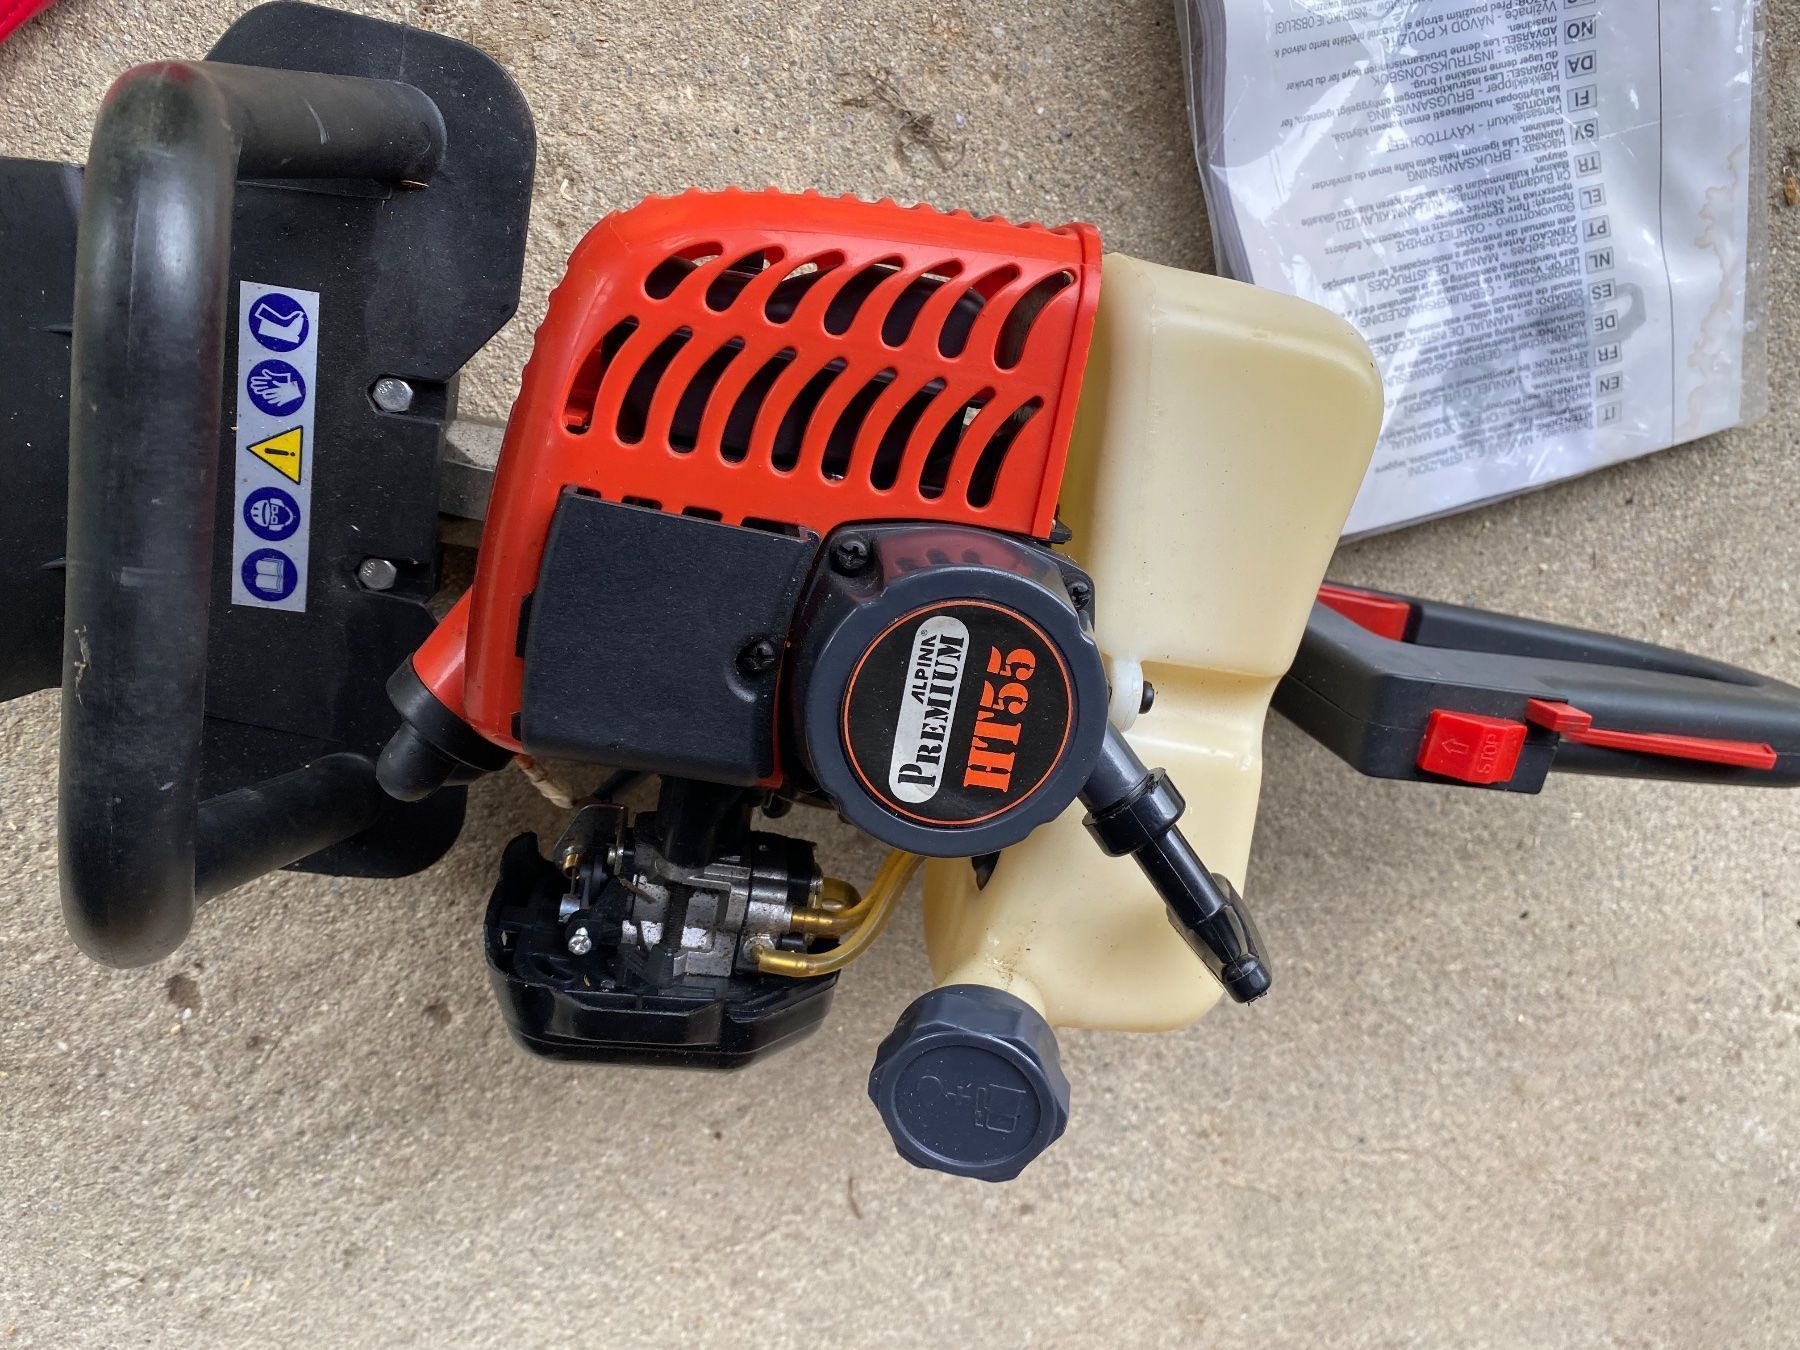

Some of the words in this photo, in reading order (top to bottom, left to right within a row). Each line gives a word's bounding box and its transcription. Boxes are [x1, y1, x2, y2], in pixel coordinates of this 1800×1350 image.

[1414, 11, 1443, 29] stroje
[1451, 13, 1494, 36] NÁVOD
[1507, 14, 1557, 34] maskinen.
[1567, 18, 1592, 40] NO
[1439, 23, 1447, 37] K
[1502, 24, 1558, 45] ADVARSEL:
[1449, 41, 1480, 57] denne
[1482, 36, 1499, 49] Les
[1505, 34, 1557, 57] Hekksaks
[1519, 51, 1542, 66] tager
[1546, 49, 1558, 60] du
[1569, 53, 1593, 74] DA
[1445, 65, 1487, 83] maskine
[1489, 58, 1517, 73] denne
[1506, 58, 1558, 79] ADVARSEL:
[1285, 77, 1313, 92] bruker
[1394, 74, 1480, 104] instruktionsbogen
[1410, 75, 1436, 91] brug.
[1485, 65, 1558, 96] Hækkeklipper
[1367, 87, 1473, 123] BRUGSANVISNING
[1512, 92, 1560, 112] VAROITUS:
[1574, 88, 1589, 107] FI
[1403, 112, 1429, 124] ennen
[1432, 98, 1493, 119] huolellisesti
[1487, 102, 1561, 130] Pensasleikkuri
[1520, 116, 1563, 135] maskinen.
[1521, 126, 1564, 144] VARNING:
[1574, 122, 1593, 141] SV
[1461, 139, 1498, 157] igenom
[1407, 148, 1510, 181] BRUKSANVISNING
[1578, 155, 1596, 173] TR
[1509, 171, 1553, 192] Budama
[1584, 187, 1600, 205] EL
[1585, 219, 1605, 237] PT
[1453, 251, 1498, 272] MANUAL
[1590, 250, 1609, 269] NL
[1592, 282, 1611, 300] ES
[1450, 325, 1463, 338] DE
[1467, 313, 1513, 334] MANUAL
[1594, 313, 1615, 331] DE
[1598, 345, 1617, 362] FR
[1599, 375, 1619, 392] EN
[1601, 405, 1615, 421] IT
[963, 645, 1036, 793] HT55
[1477, 733, 1498, 775] STOP
